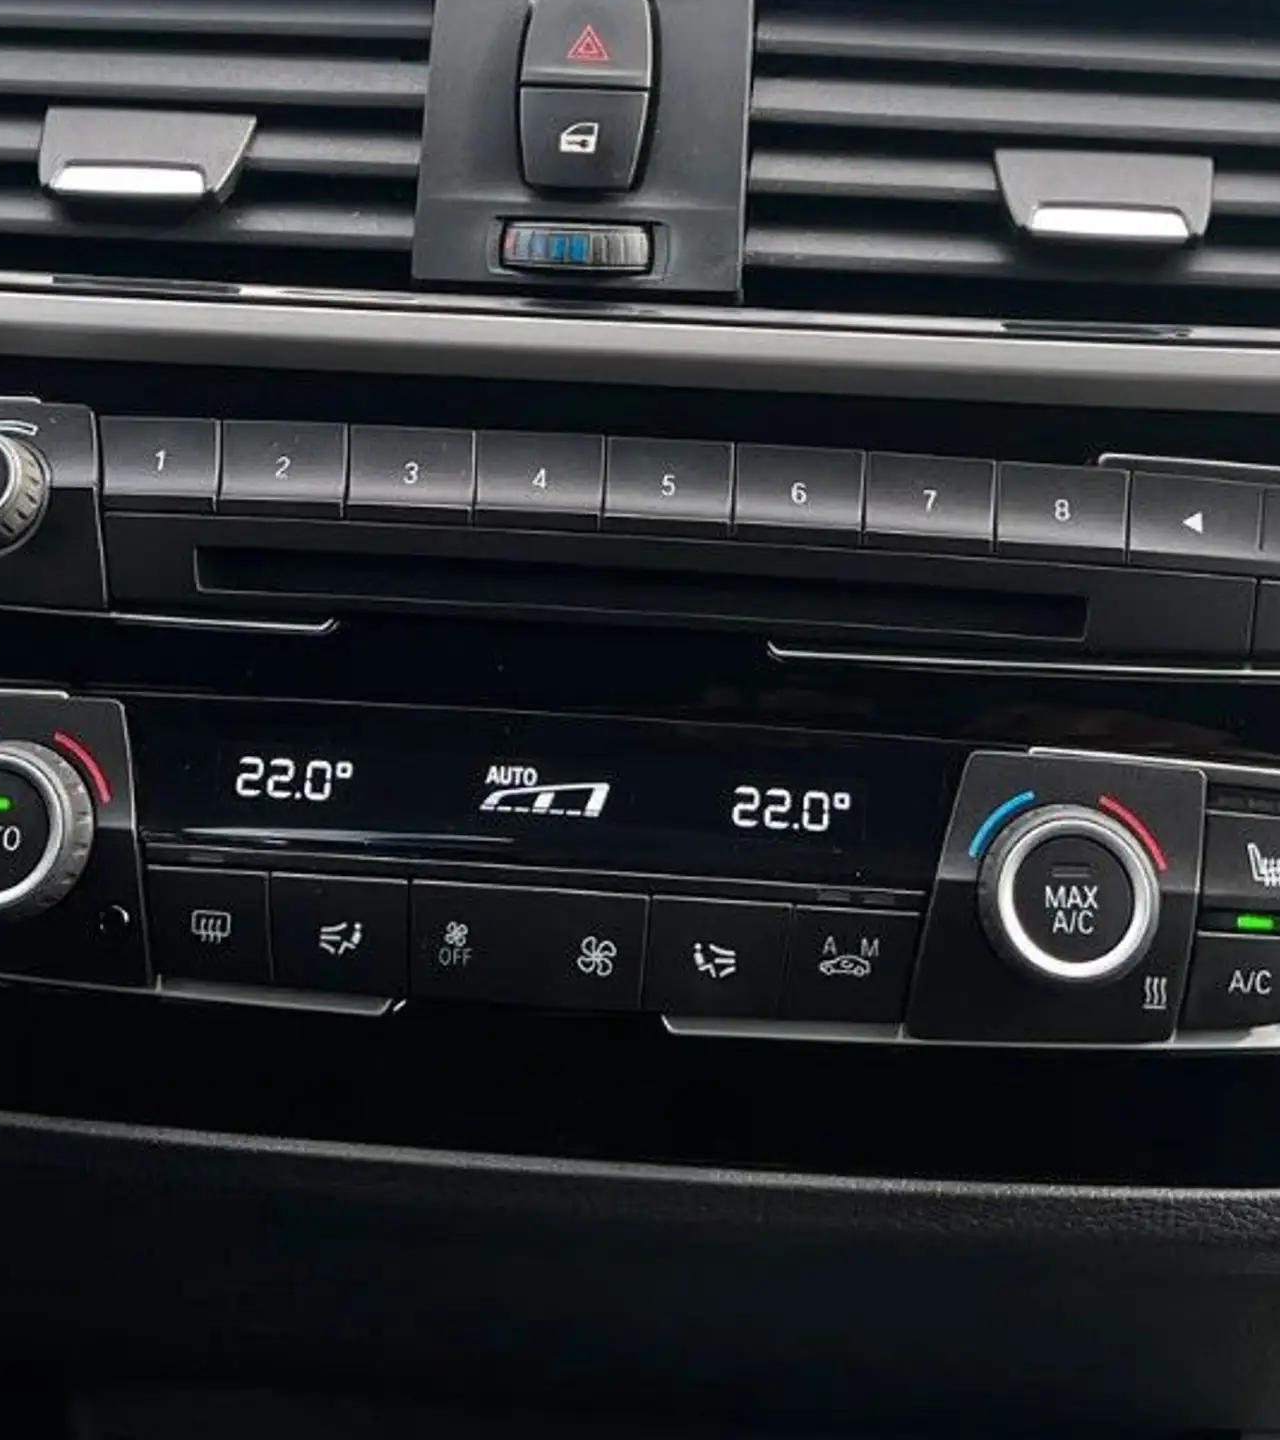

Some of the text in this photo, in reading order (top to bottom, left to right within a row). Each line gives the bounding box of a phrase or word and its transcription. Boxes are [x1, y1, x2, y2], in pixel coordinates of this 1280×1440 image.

[153, 449, 167, 472] 1
[274, 455, 292, 480] 2
[402, 462, 421, 486] 3
[531, 467, 548, 491] 4
[660, 474, 677, 498] 5
[790, 481, 808, 506] 6
[922, 489, 940, 513] 7
[1053, 499, 1072, 522] 8
[484, 764, 539, 788] AUTO
[1044, 884, 1099, 910] MAX
[1052, 910, 1095, 936] A/C
[438, 947, 473, 967] OFF
[823, 936, 880, 958] A M
[1227, 970, 1274, 996] A/C
